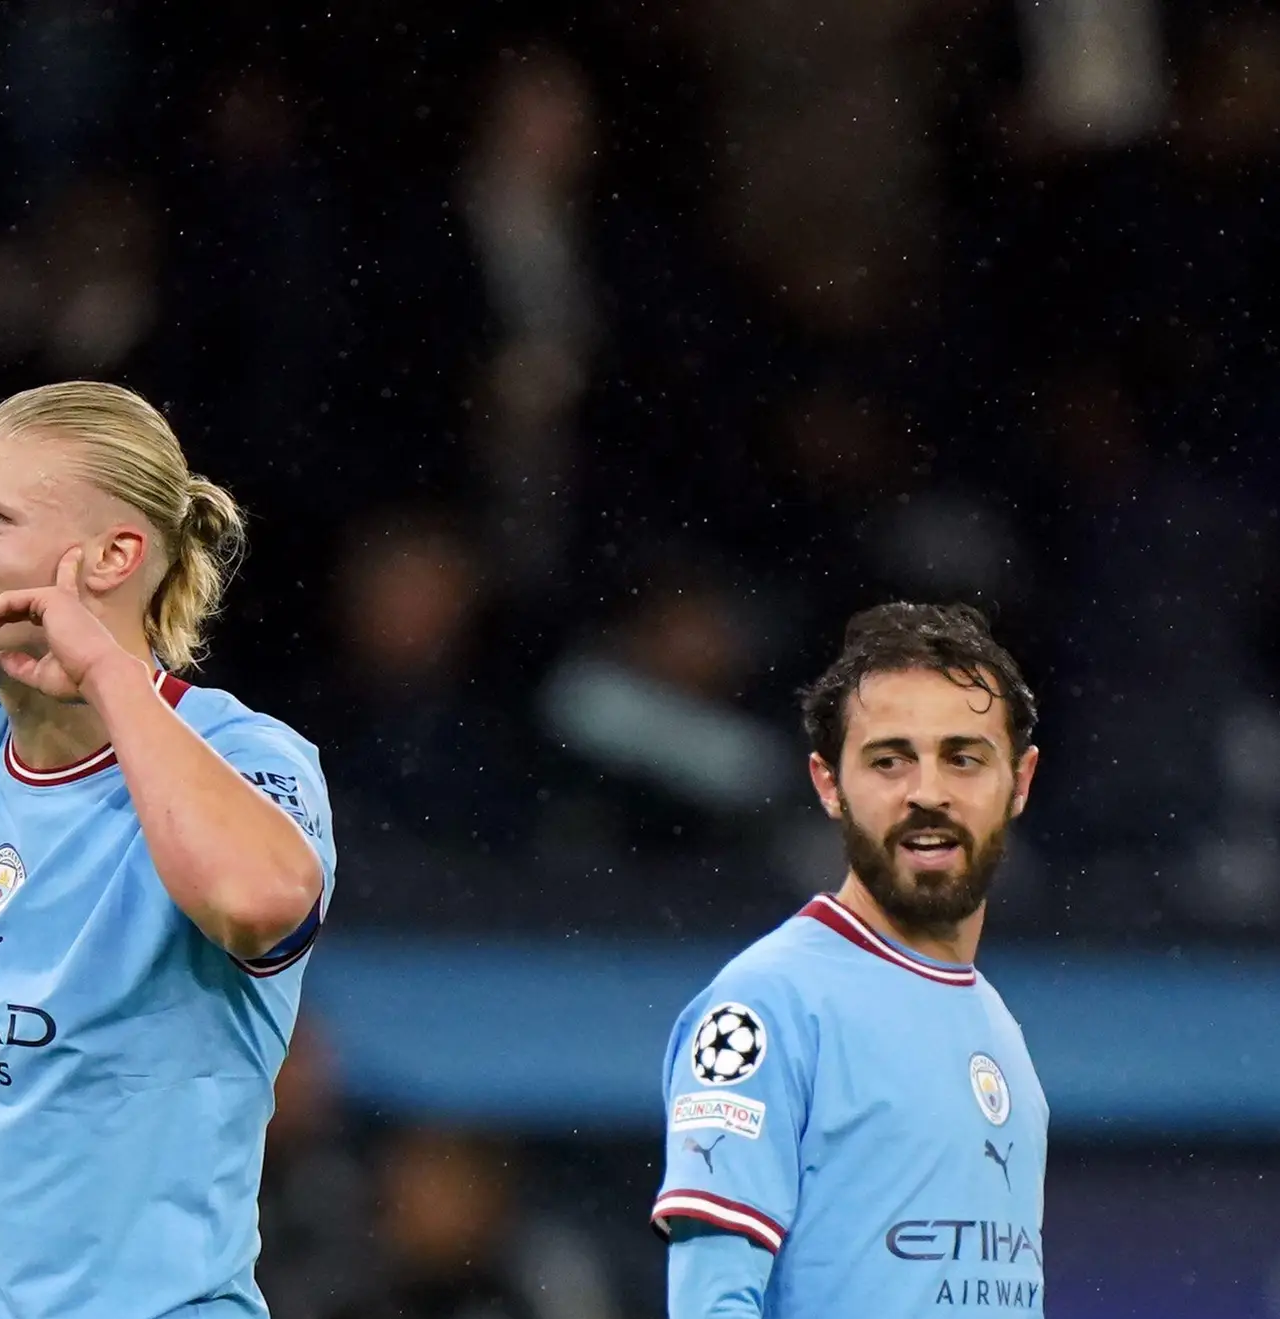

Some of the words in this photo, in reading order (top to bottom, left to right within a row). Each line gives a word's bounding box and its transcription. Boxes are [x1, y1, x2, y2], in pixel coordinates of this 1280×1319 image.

[675, 1103, 761, 1126] FOUNDATION
[885, 1220, 1044, 1267] ETIHA
[935, 1279, 1040, 1309] AIRWAY
